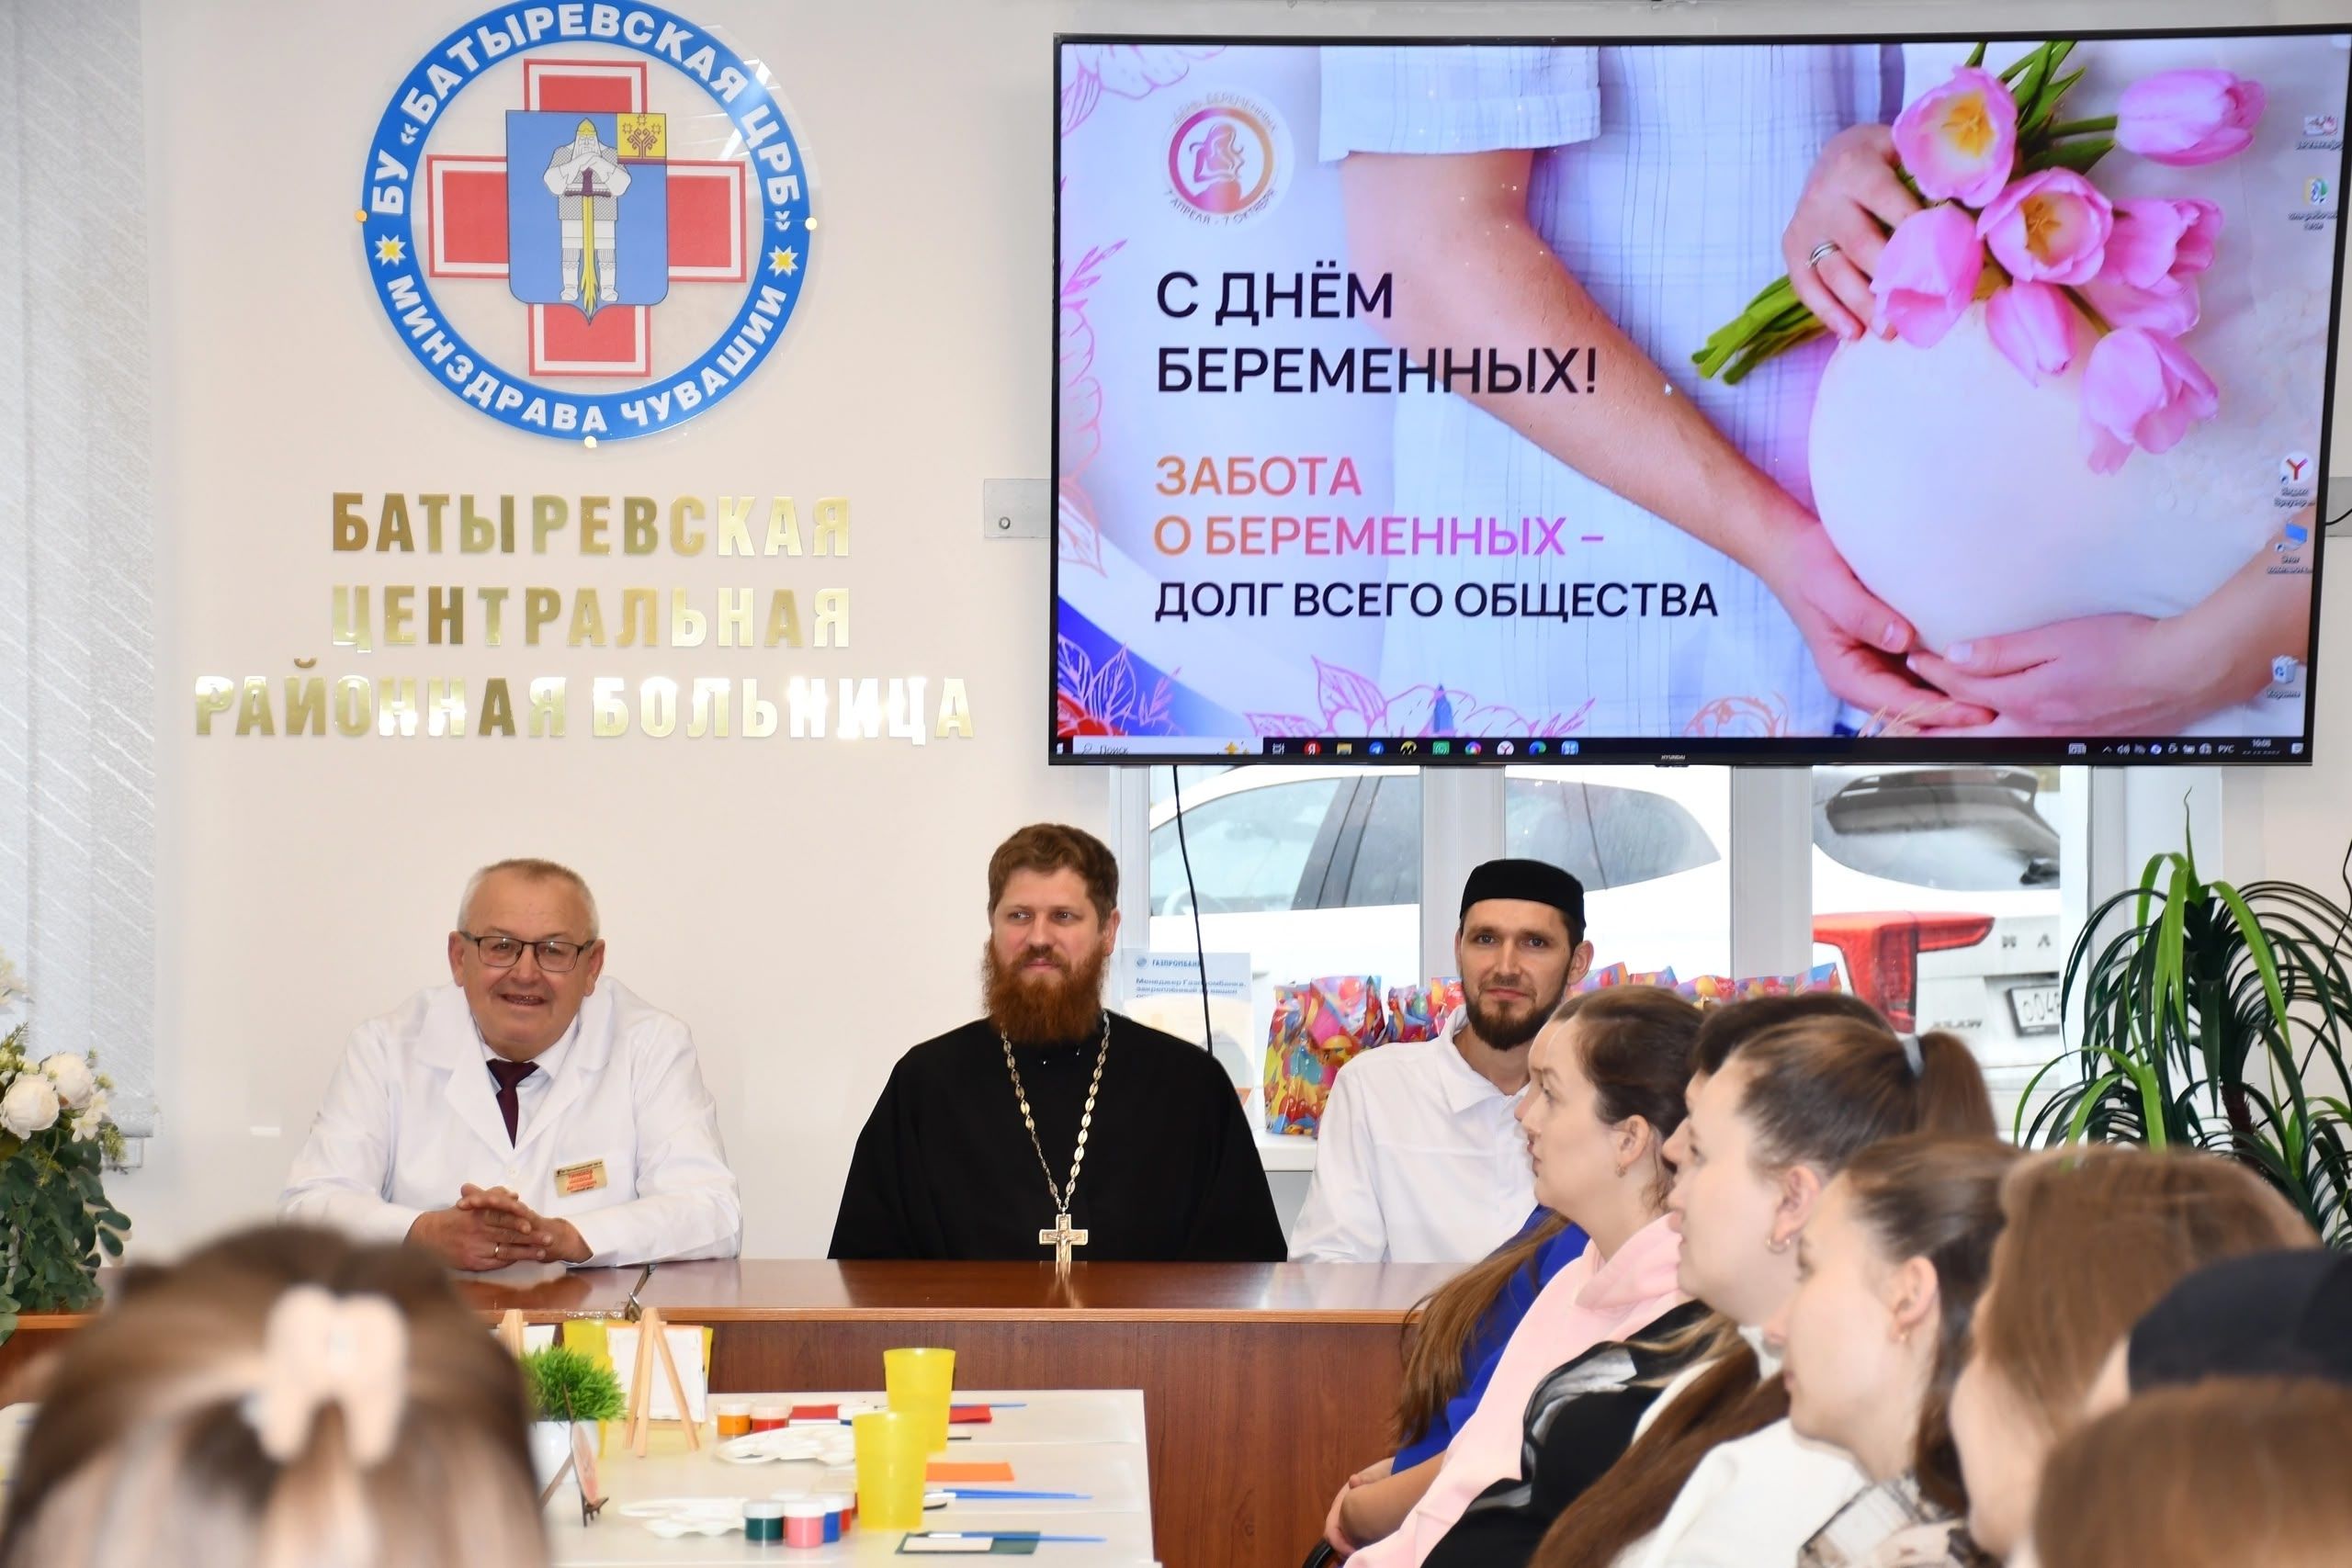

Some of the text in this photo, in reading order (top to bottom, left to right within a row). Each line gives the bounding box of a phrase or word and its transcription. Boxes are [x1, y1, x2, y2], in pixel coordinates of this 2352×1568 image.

[371, 3, 799, 231] БУ «БАТЫРЕВСКАЯ ЦРБ»
[1156, 260, 1394, 327] С ДНЁМ
[387, 274, 787, 433] МИНЗДРАВА ЧУВАШИИ
[1158, 346, 1598, 394] БЕРЕМЕННЫХ!
[1155, 455, 1363, 498] ЗАБОТА
[332, 491, 850, 557] БАТЫРЕВСКАЯ
[1153, 515, 1192, 556] О
[1205, 515, 1567, 556] БЕРЕМЕННЫХ
[332, 584, 850, 653] ЦЕНТРАЛЬНАЯ
[1154, 581, 1718, 623] ДОЛГ ВСЕГО ОБЩЕСТВА
[194, 657, 976, 745] РАЙОННАЯ БОЛЬНИЦА
[1151, 958, 1202, 967] ГАЗПРОМБАН
